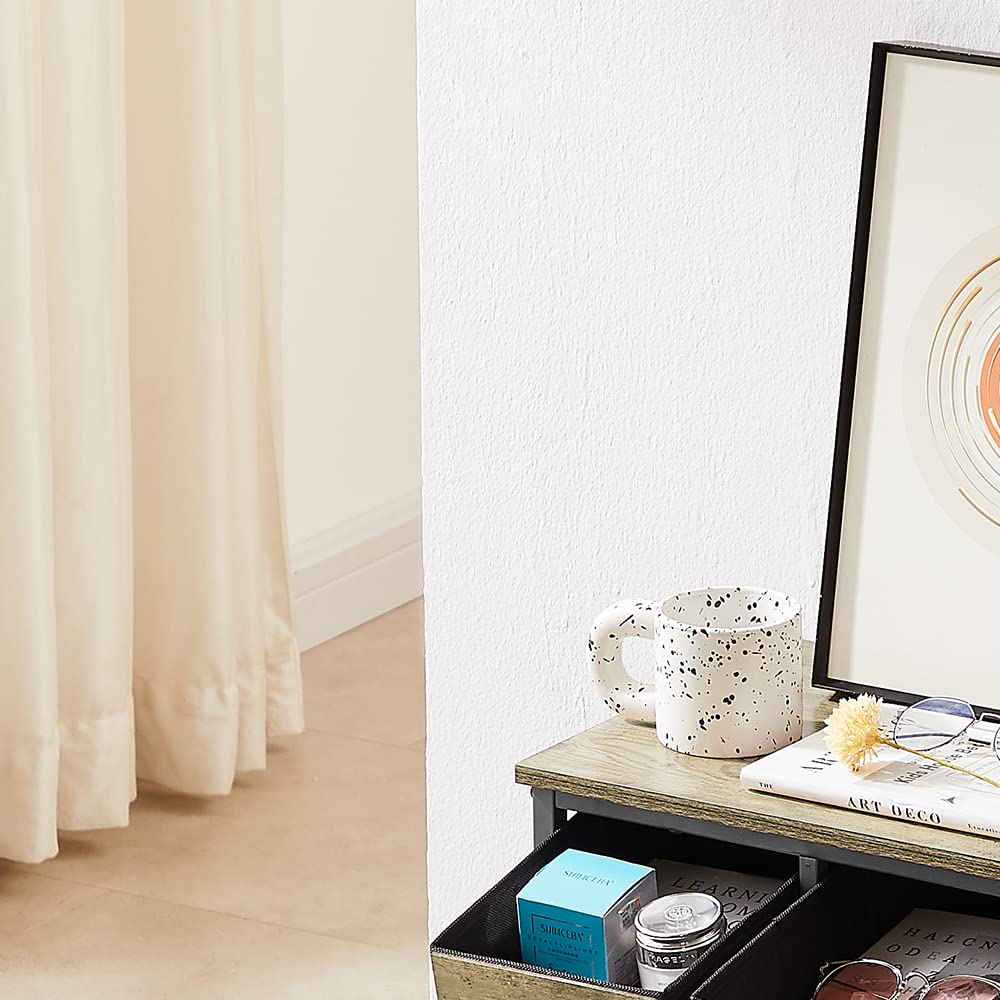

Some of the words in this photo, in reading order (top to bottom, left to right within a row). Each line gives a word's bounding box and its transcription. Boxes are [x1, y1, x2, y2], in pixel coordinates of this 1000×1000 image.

[894, 769, 928, 784] Kids
[848, 796, 881, 812] ART
[891, 804, 941, 824] DECO
